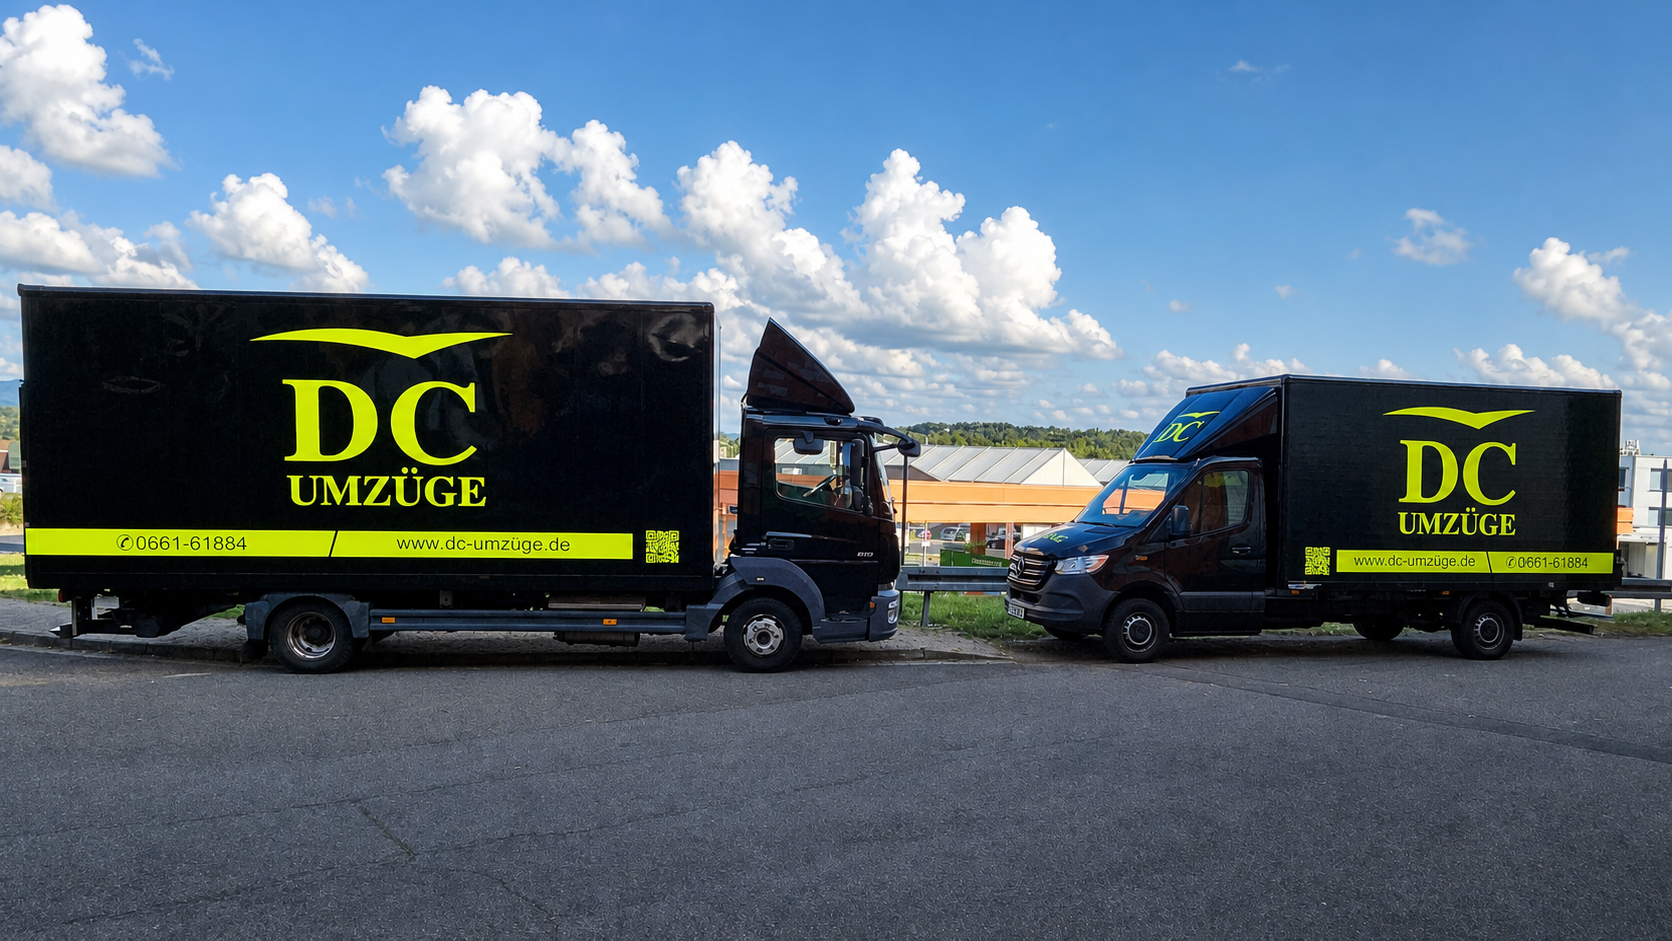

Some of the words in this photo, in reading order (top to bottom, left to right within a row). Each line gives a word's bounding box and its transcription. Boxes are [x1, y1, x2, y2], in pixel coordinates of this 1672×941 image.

[282, 379, 477, 467] DC
[1154, 420, 1204, 442] DC
[1398, 439, 1517, 506] DC
[287, 467, 487, 507] UMZÜGE
[1398, 507, 1516, 536] UMZÜGE
[136, 535, 247, 551] 0661-61884
[396, 535, 571, 555] www.dc-umzüge.de
[1353, 554, 1476, 571] www.dc-umzüge.de
[1517, 556, 1589, 569] 0661-61884
